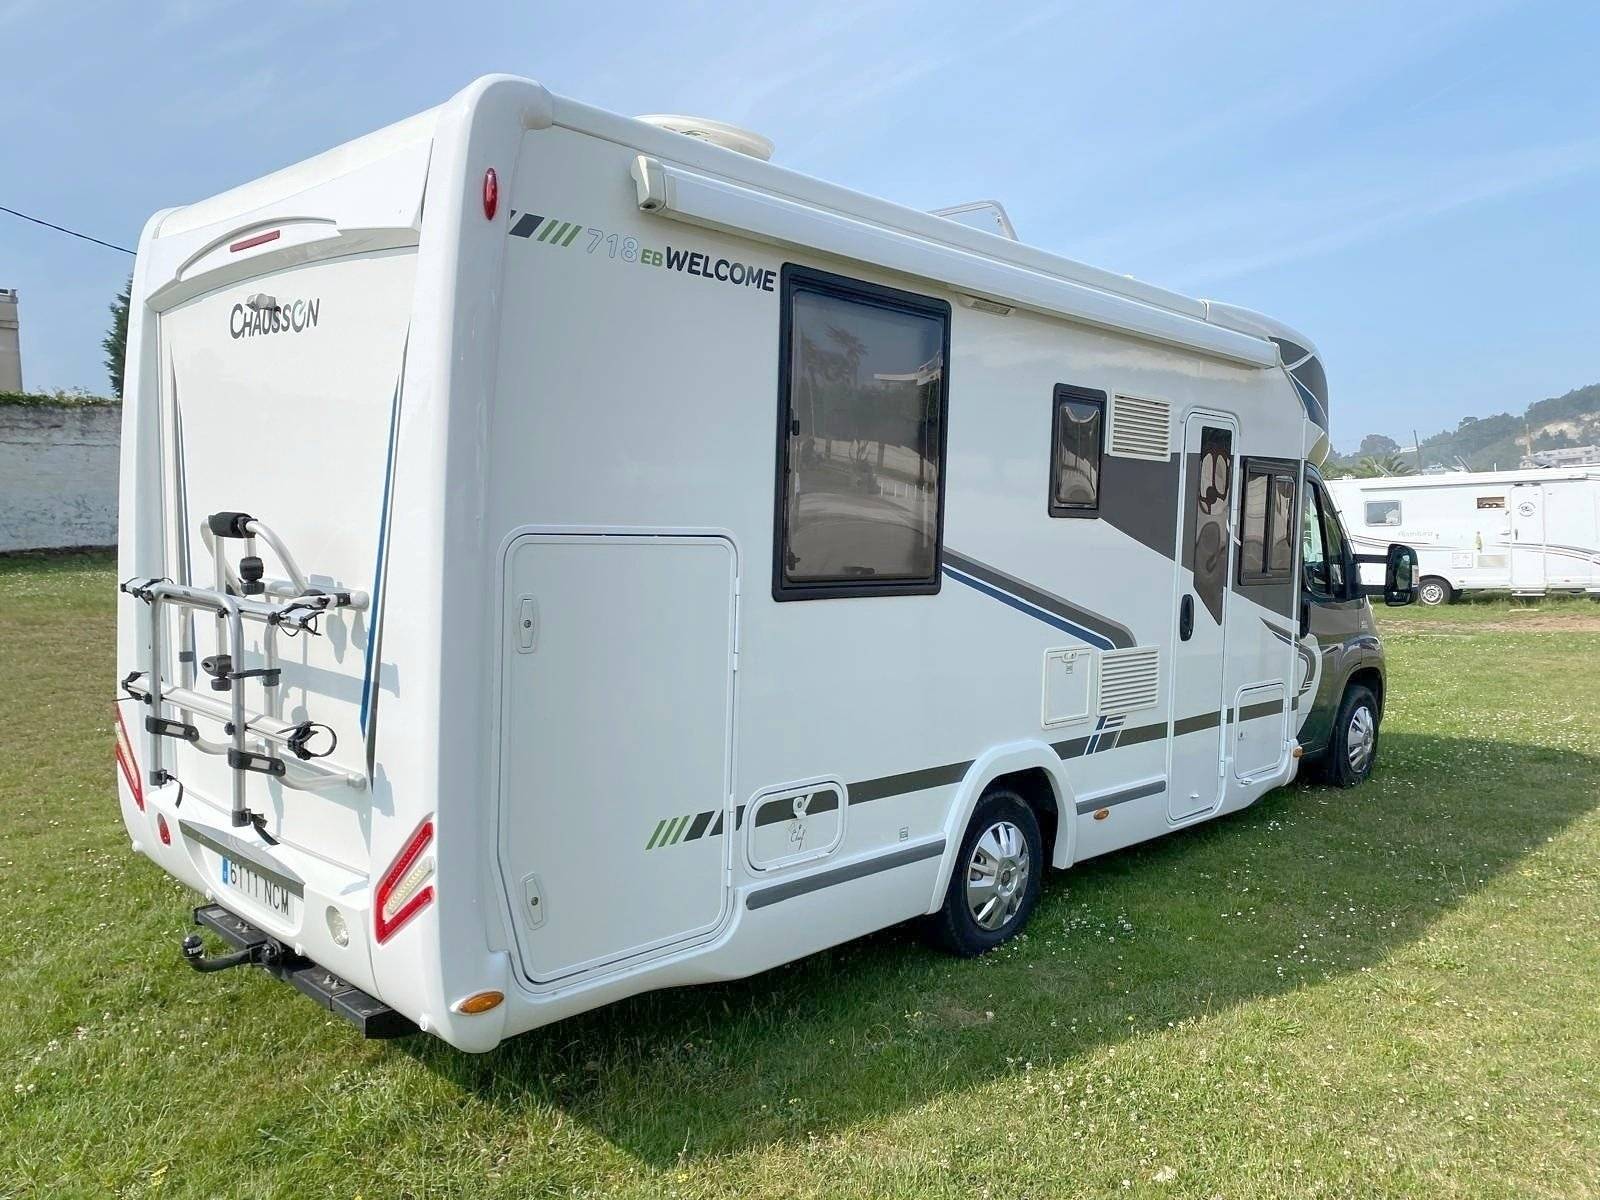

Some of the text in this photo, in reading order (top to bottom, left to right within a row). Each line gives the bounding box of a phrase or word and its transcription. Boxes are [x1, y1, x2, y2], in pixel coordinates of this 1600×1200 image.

[586, 227, 777, 292] 718 EB WELCOME
[229, 297, 320, 340] CHAUSSON
[230, 860, 289, 916] 6111 NCM
